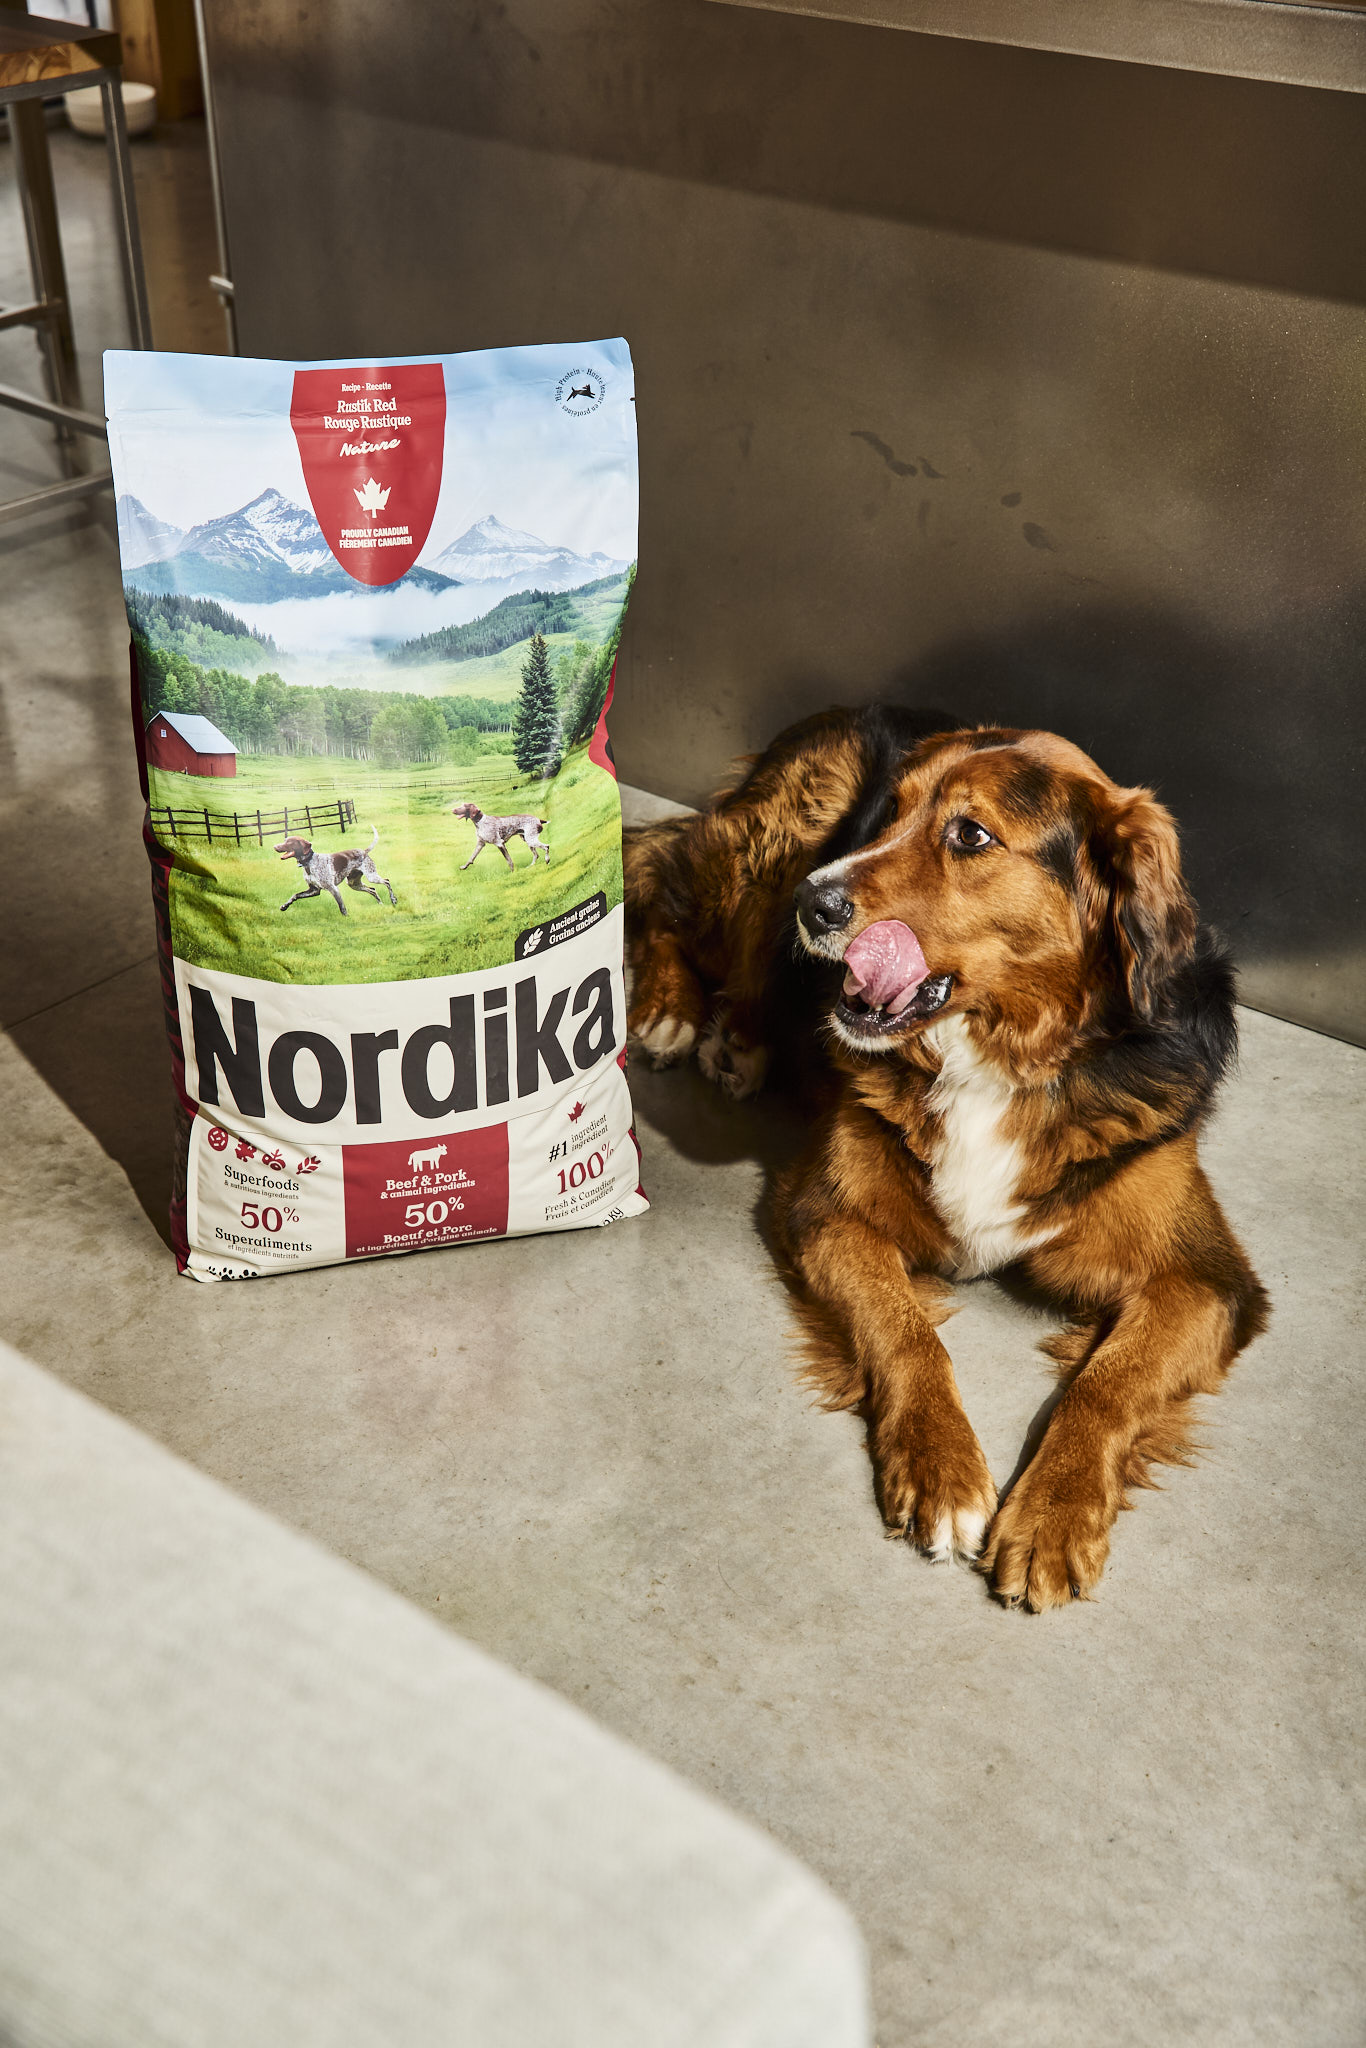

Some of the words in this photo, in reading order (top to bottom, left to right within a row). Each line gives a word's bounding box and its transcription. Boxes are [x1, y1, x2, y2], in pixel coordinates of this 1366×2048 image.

[341, 383, 361, 392] Recipe
[365, 382, 392, 391] Recette
[558, 368, 580, 385] Protein
[337, 398, 372, 413] Rustik
[373, 397, 397, 412] Red
[323, 416, 360, 432] Rouge
[361, 414, 411, 430] Rustique
[339, 438, 401, 457] Nature
[339, 537, 377, 549] FIÈREMENT
[377, 536, 412, 547] CANADIEN
[341, 528, 372, 539] PROUDLY
[373, 526, 409, 538] CANADIAN
[549, 911, 578, 934] Ancient
[578, 899, 600, 921] grains
[549, 927, 575, 945] Grains
[575, 910, 601, 932] anciens
[188, 967, 617, 1125] Nordika
[548, 1140, 568, 1163] #1
[224, 1164, 299, 1191] Superfoods
[557, 1140, 615, 1195] 100%
[380, 1191, 388, 1200] &
[389, 1186, 422, 1199] animal
[423, 1178, 476, 1196] ingredients
[386, 1175, 419, 1191] Beef
[420, 1175, 432, 1187] &
[434, 1168, 468, 1184] Pork
[230, 1182, 260, 1195] nutritious
[261, 1189, 299, 1200] ingredients
[545, 1199, 569, 1215] Fresh
[570, 1196, 577, 1204] &
[578, 1176, 616, 1201] Canadian
[240, 1202, 300, 1233] 50%
[404, 1195, 465, 1228] 50%
[545, 1208, 569, 1221] Frais
[570, 1205, 579, 1214] et
[215, 1227, 312, 1252] Superaliments
[383, 1229, 424, 1244] Boeuf
[425, 1228, 438, 1238] et
[442, 1223, 473, 1235] Porc
[461, 1227, 497, 1238] animale
